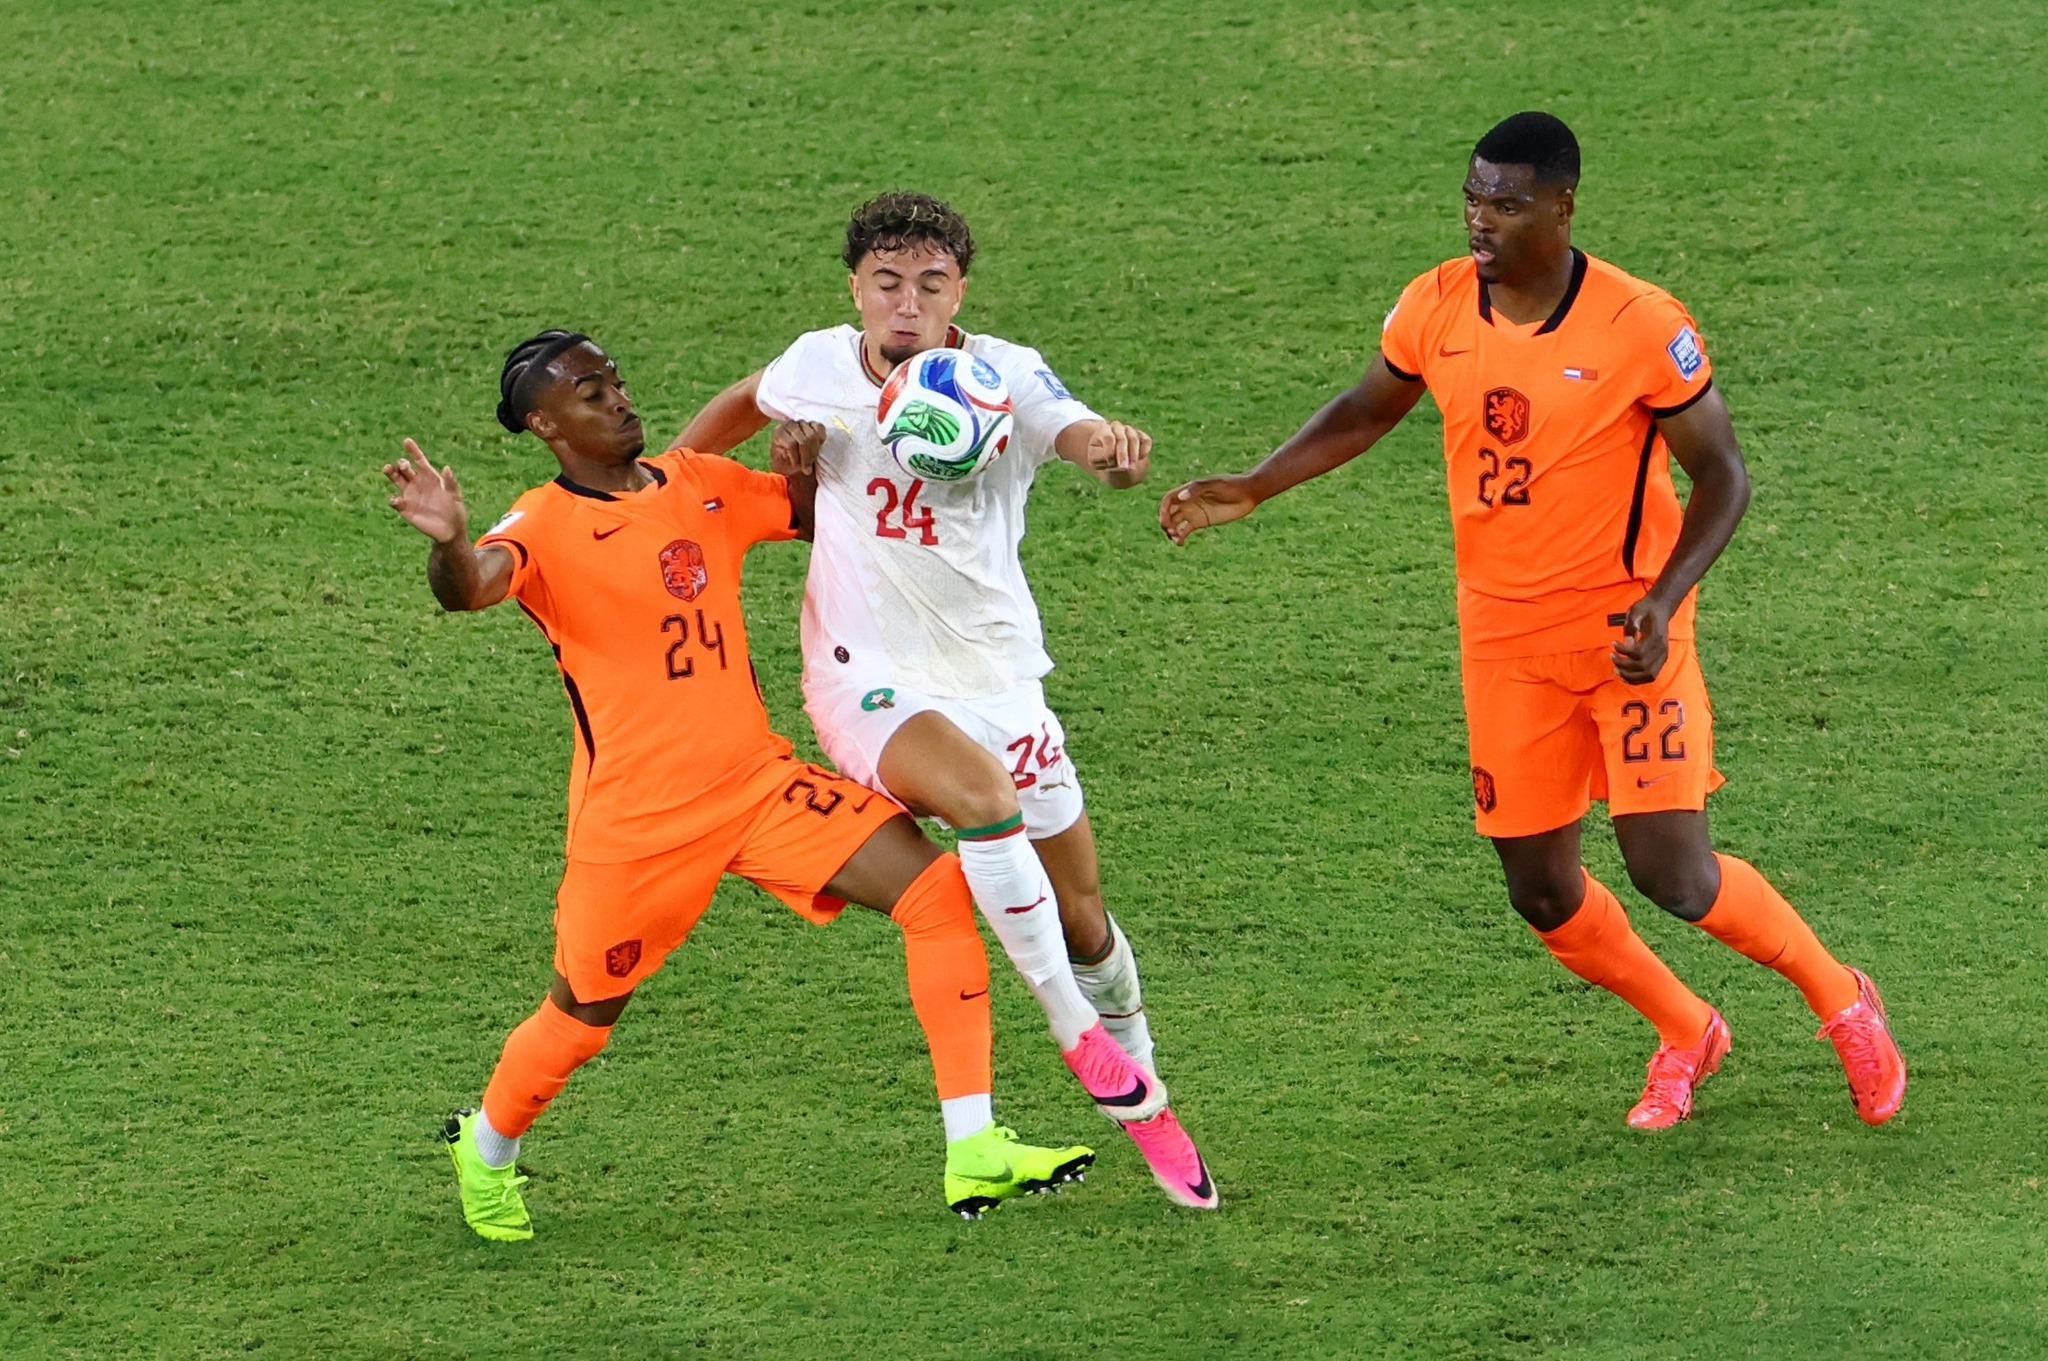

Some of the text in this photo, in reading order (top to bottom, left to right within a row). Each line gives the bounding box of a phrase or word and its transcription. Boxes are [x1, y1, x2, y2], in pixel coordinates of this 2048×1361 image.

[866, 477, 939, 545] 24
[1477, 447, 1533, 508] 22
[660, 609, 727, 681] 24
[1006, 721, 1061, 790] 24
[1621, 698, 1687, 764] 22
